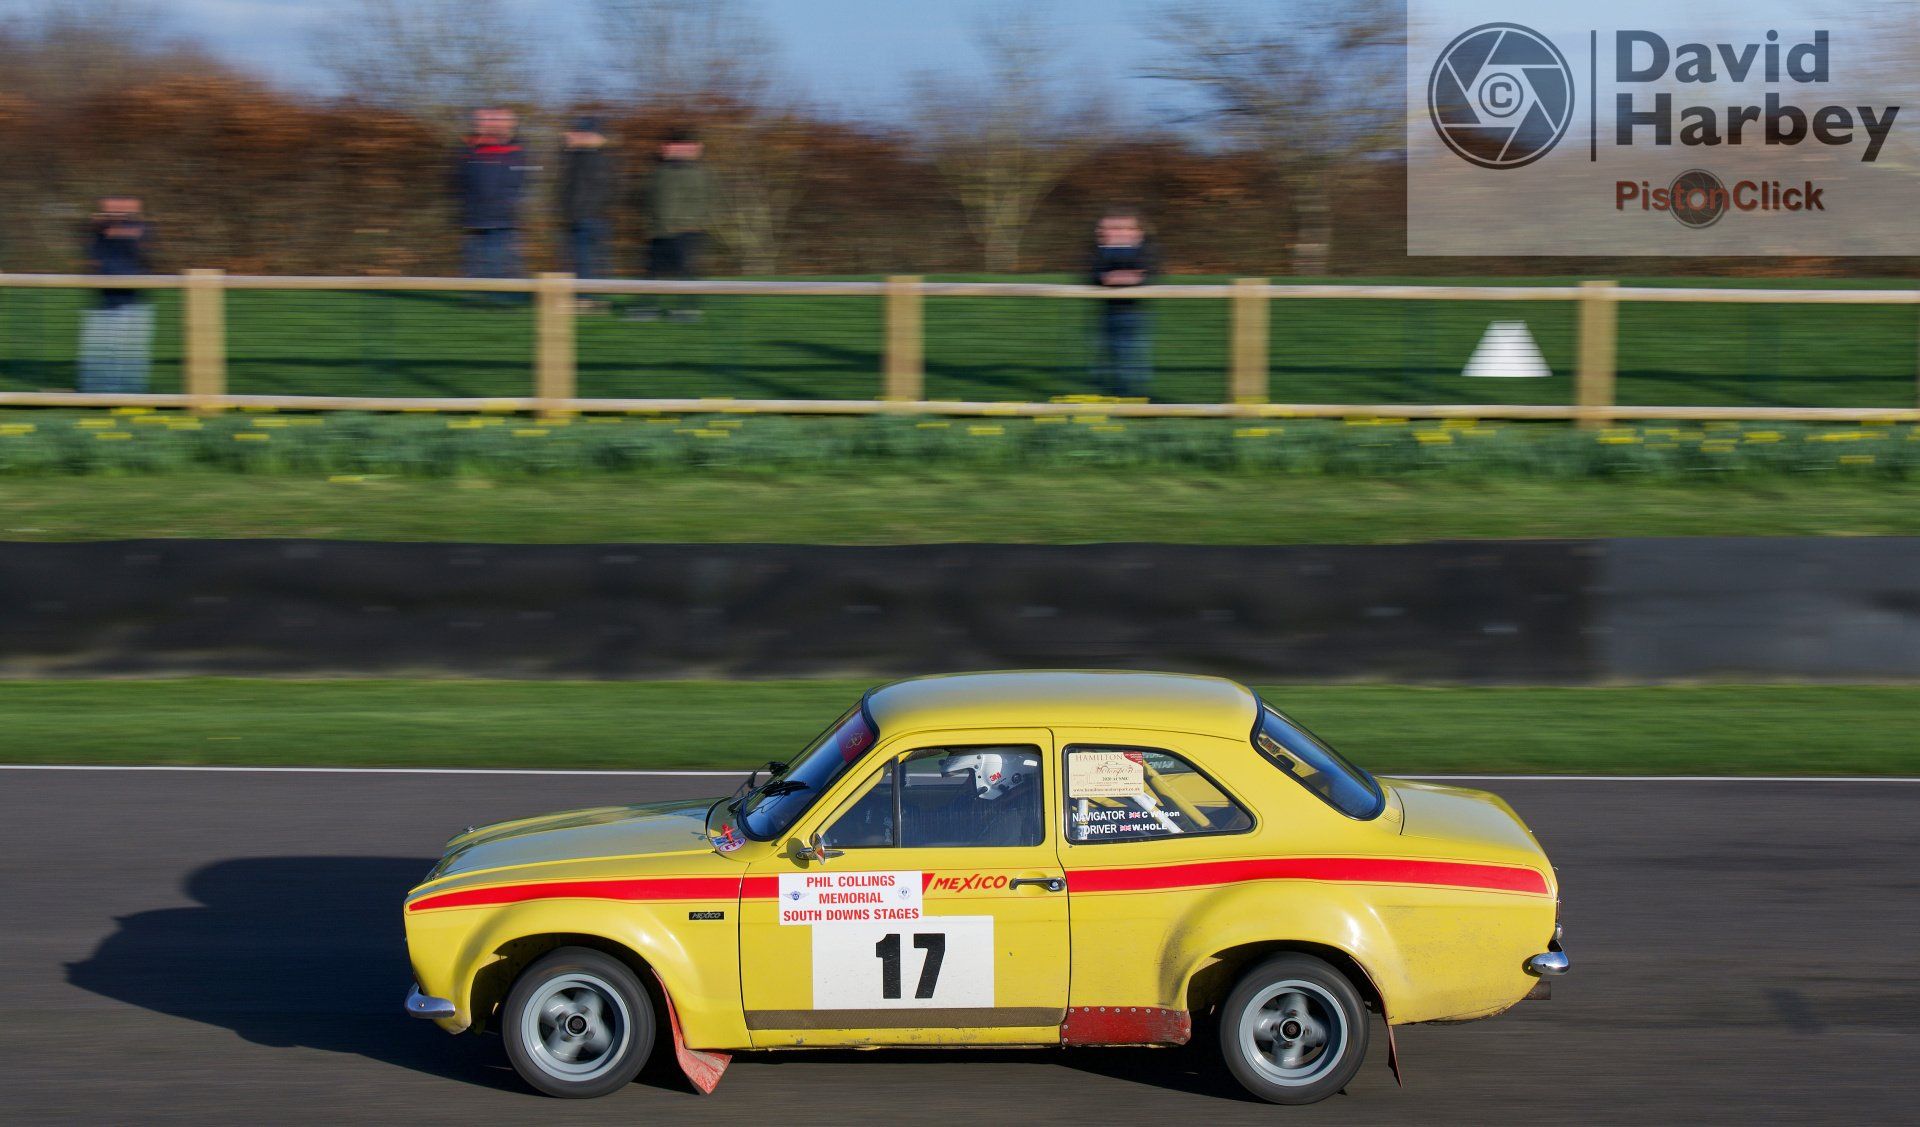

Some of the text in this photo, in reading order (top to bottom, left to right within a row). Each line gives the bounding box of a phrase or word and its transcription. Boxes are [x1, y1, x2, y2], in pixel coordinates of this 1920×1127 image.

[1075, 753, 1122, 761] HAMILTON
[990, 771, 1002, 782] 3M
[1072, 811, 1126, 822] NAVIGATOR
[1083, 824, 1118, 835] DRIVER
[806, 875, 896, 888] PHIL COLLINGS
[932, 873, 1008, 893] MEXICO
[819, 891, 884, 904] MEMORIAL
[783, 908, 919, 922] SOUTH DOWNS STAGES
[875, 932, 946, 1000] 17
